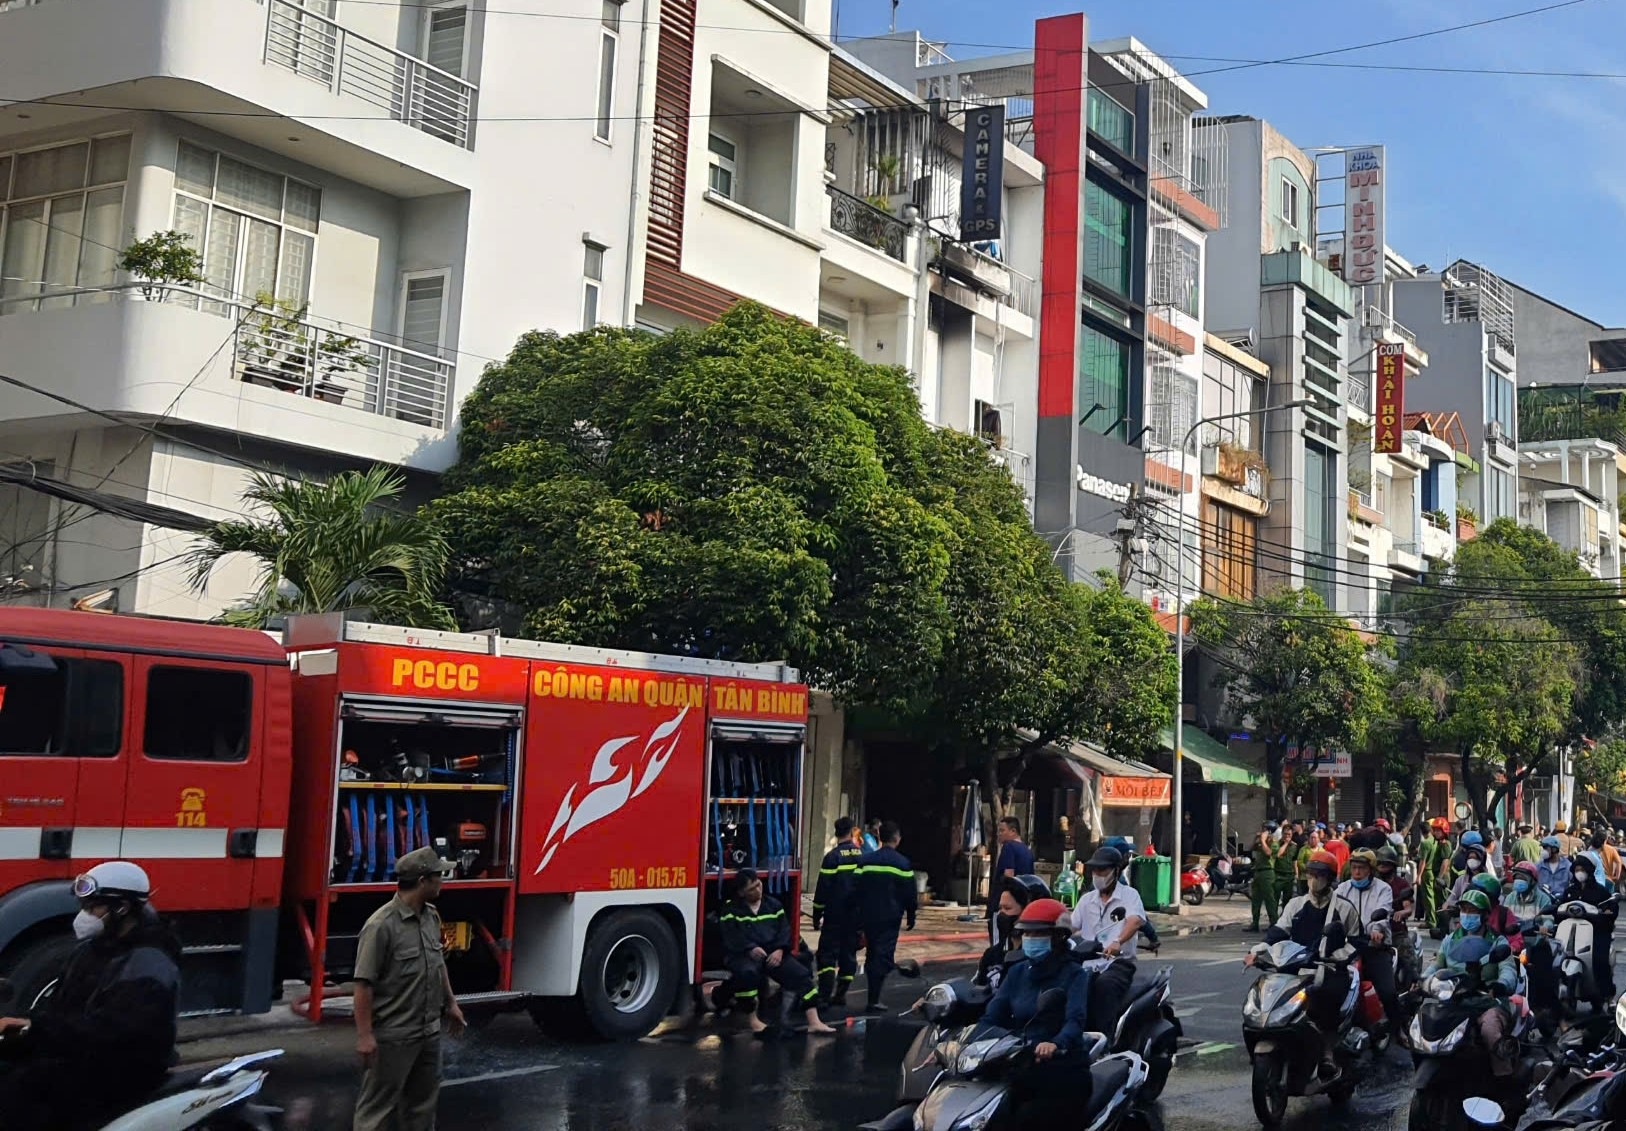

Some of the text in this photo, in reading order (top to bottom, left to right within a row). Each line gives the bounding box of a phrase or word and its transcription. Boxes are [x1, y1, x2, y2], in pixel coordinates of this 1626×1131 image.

[975, 114, 990, 198] CAMERA
[1349, 162, 1380, 172] KHOA
[1353, 152, 1377, 161] NHA
[964, 218, 995, 232] GPS
[1350, 170, 1379, 282] MINH ĐỨC
[1381, 404, 1395, 450] HOÀN
[1076, 464, 1131, 504] Panasoni
[392, 658, 479, 691] PCCC
[534, 665, 805, 716] CÔNG AN QUẬN TÂN BÌNH
[175, 811, 206, 827] 114
[610, 868, 636, 889] 50A
[646, 866, 686, 888] 015.75
